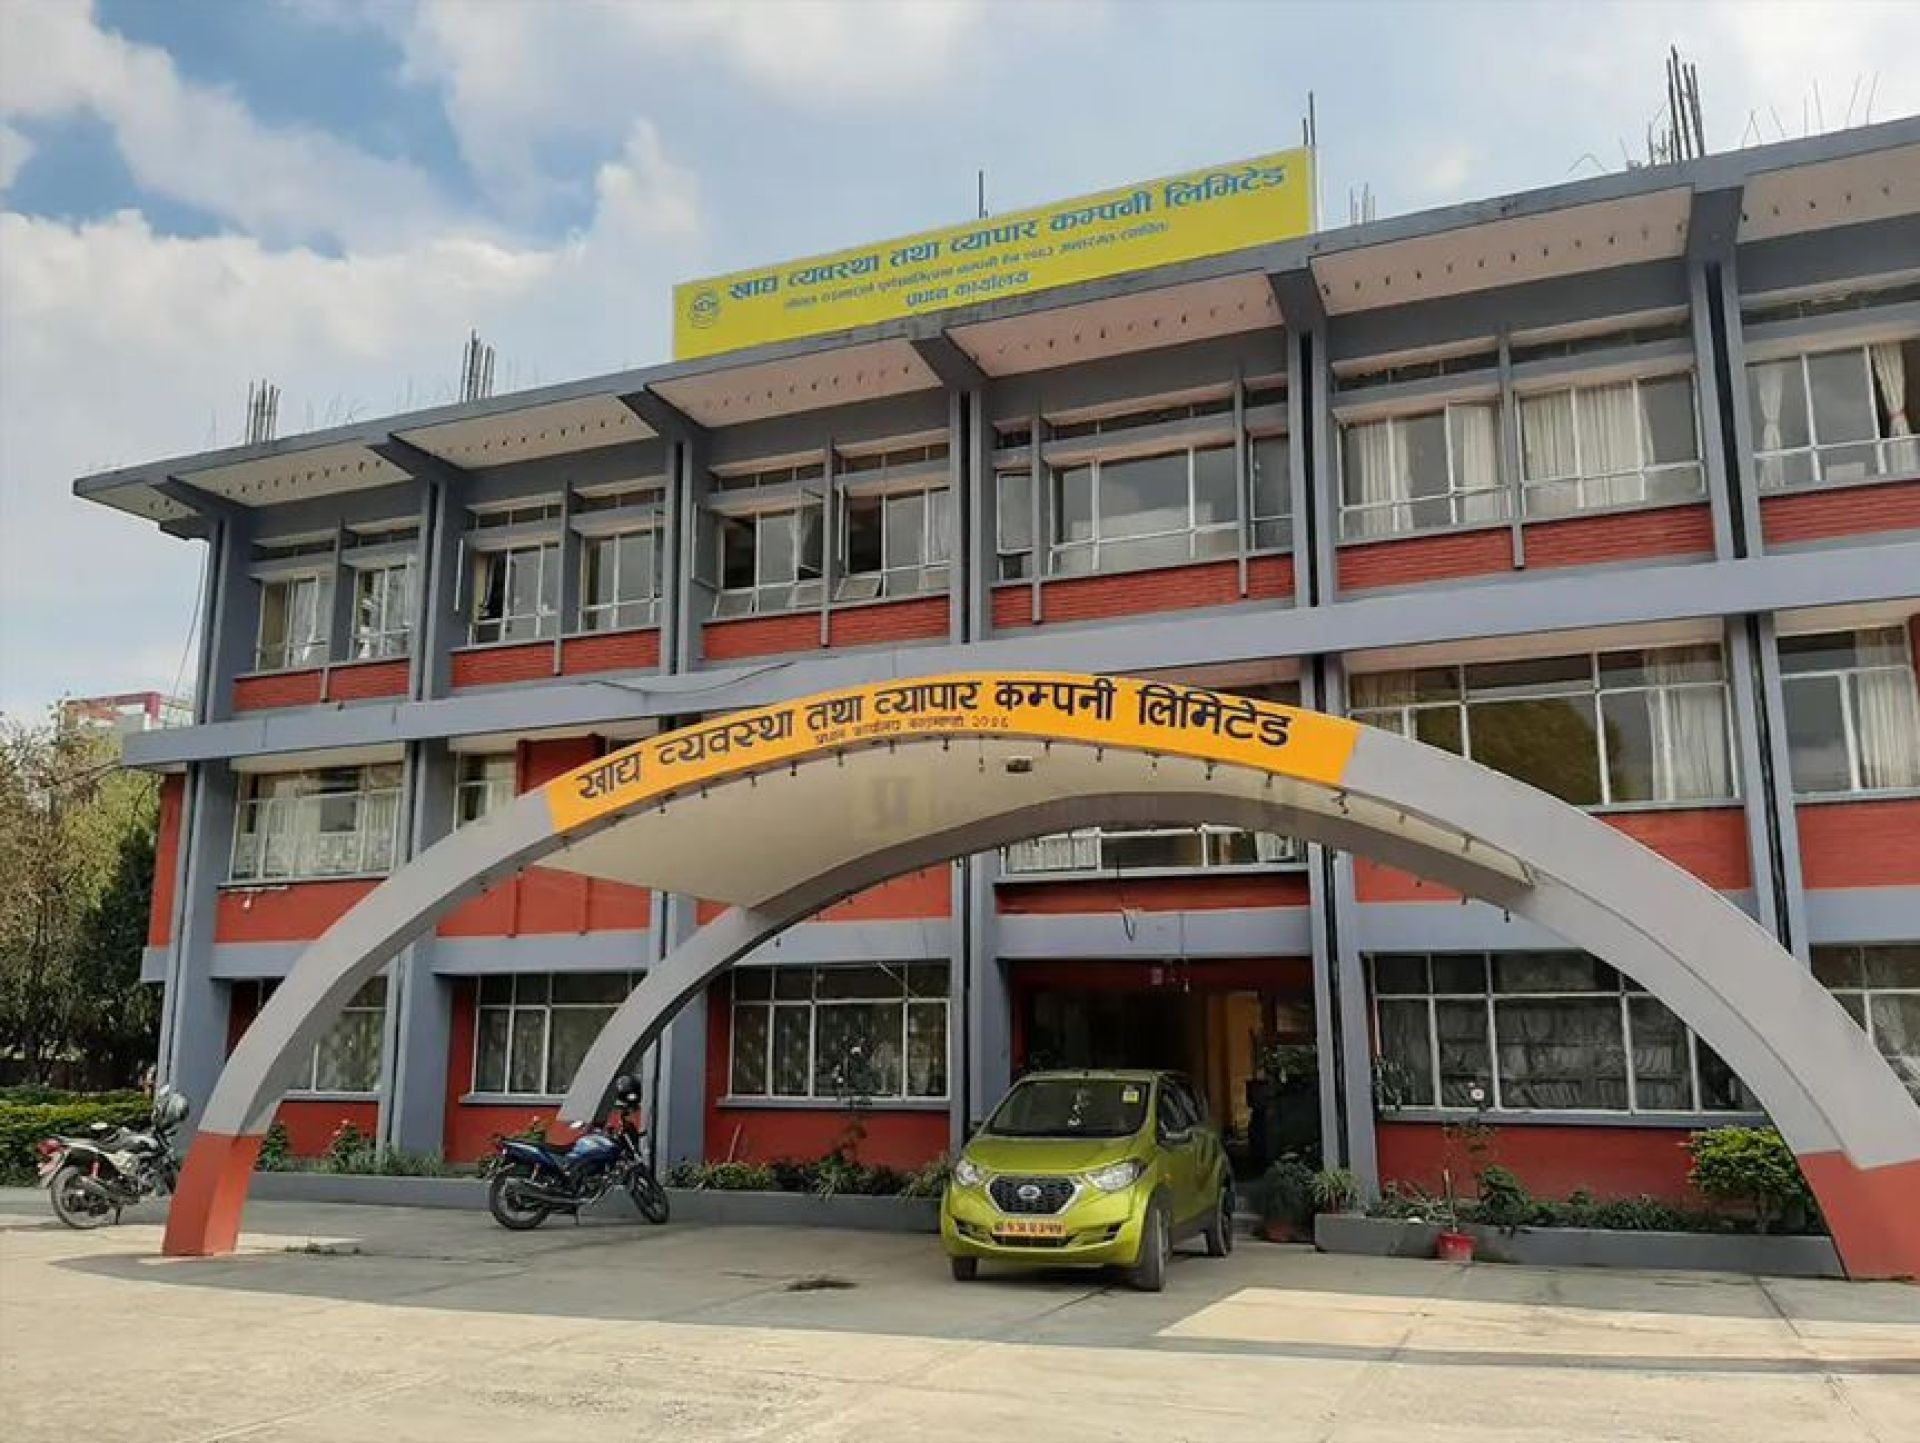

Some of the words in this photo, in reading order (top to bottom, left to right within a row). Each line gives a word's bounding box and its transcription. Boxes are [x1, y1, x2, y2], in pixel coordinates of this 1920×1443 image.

[728, 275, 778, 300] खाद्य
[787, 255, 880, 287] व्यवस्था
[889, 241, 941, 268] तथा
[951, 219, 1038, 252] व्यापार
[1050, 190, 1153, 232] कम्पनी
[1165, 165, 1286, 208] लिमिटेड
[576, 750, 642, 799] खाद्य
[655, 709, 795, 766] व्यवस्था
[804, 695, 865, 730] तथा
[873, 680, 982, 716] व्यापार
[994, 678, 1118, 721] कम्पनी
[1135, 683, 1293, 747] लिमिटेड
